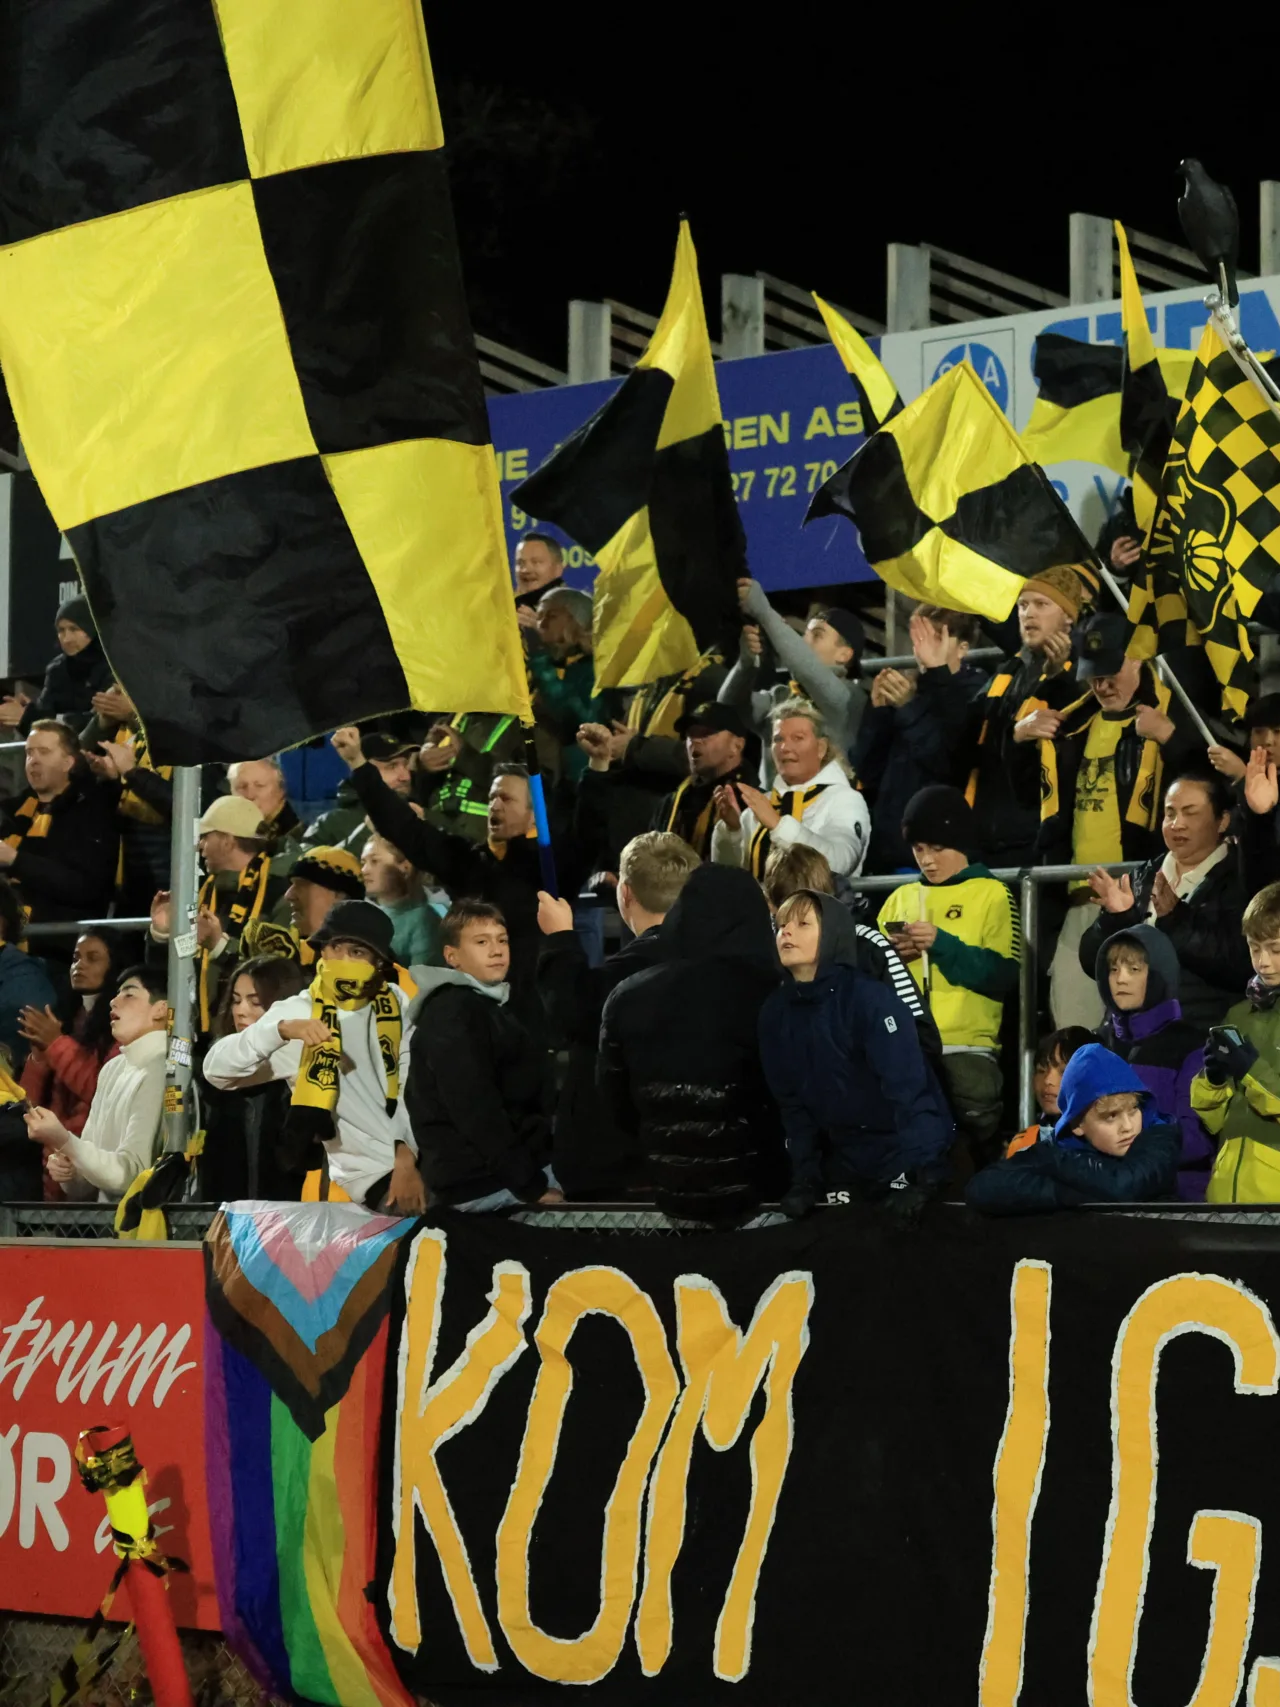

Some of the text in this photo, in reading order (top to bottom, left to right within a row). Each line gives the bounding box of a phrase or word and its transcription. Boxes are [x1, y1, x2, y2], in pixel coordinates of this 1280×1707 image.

[803, 402, 865, 440] AS
[763, 465, 797, 498] 72
[387, 1227, 816, 1686] KOM
